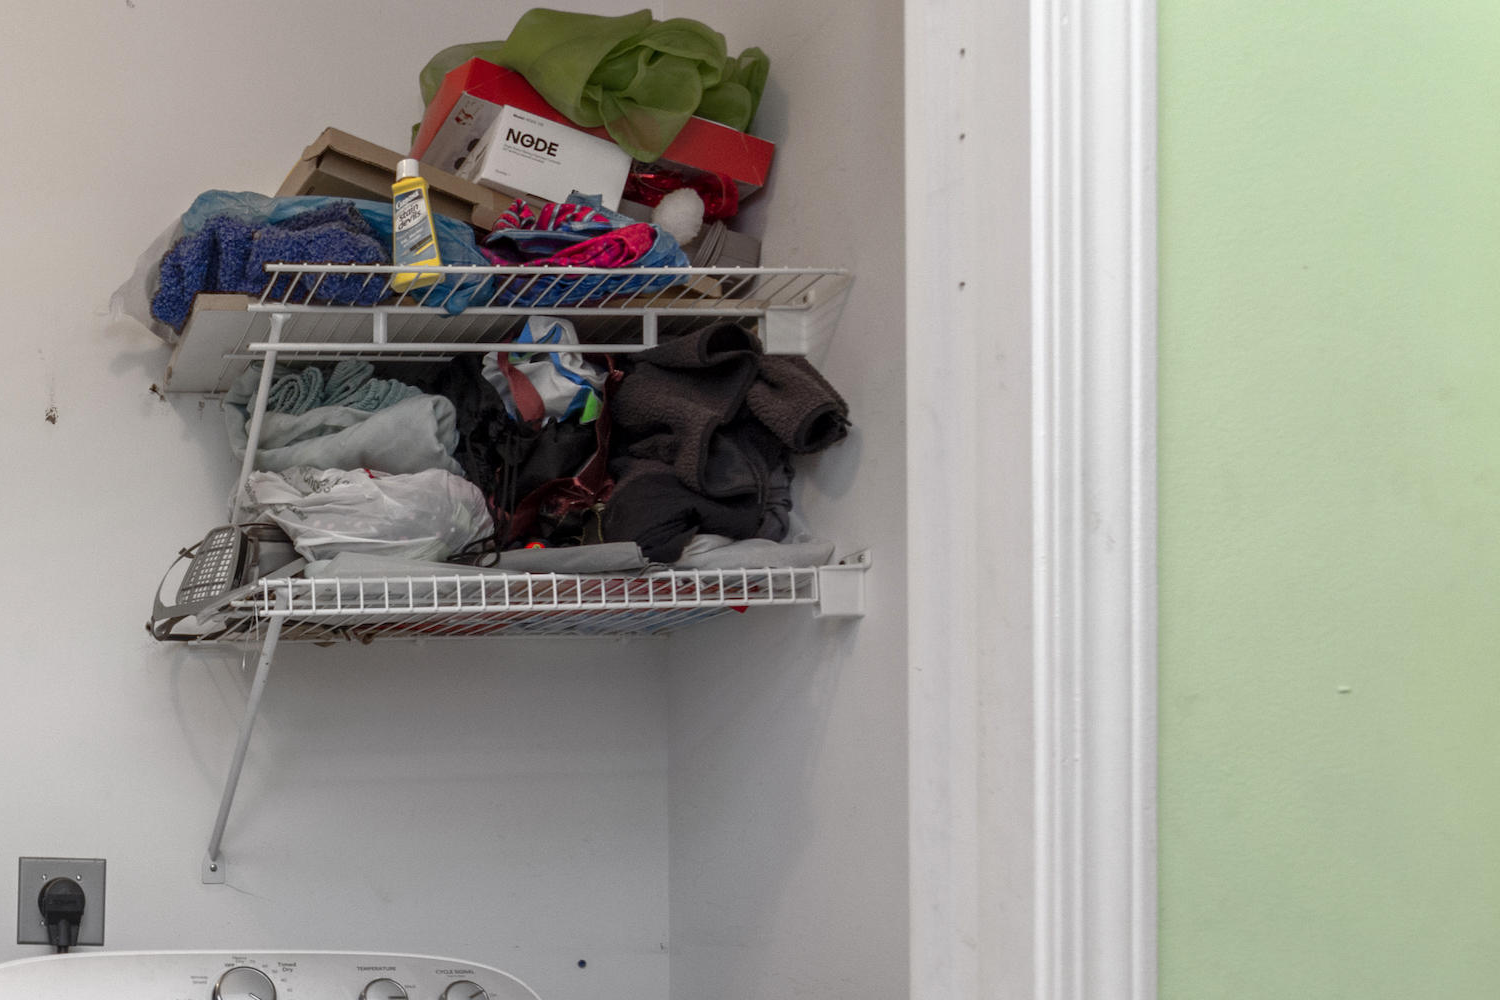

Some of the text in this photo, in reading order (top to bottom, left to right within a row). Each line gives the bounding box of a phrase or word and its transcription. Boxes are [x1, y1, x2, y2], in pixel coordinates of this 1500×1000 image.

[505, 127, 560, 157] NODE
[398, 211, 421, 230] devils
[399, 203, 419, 219] stain
